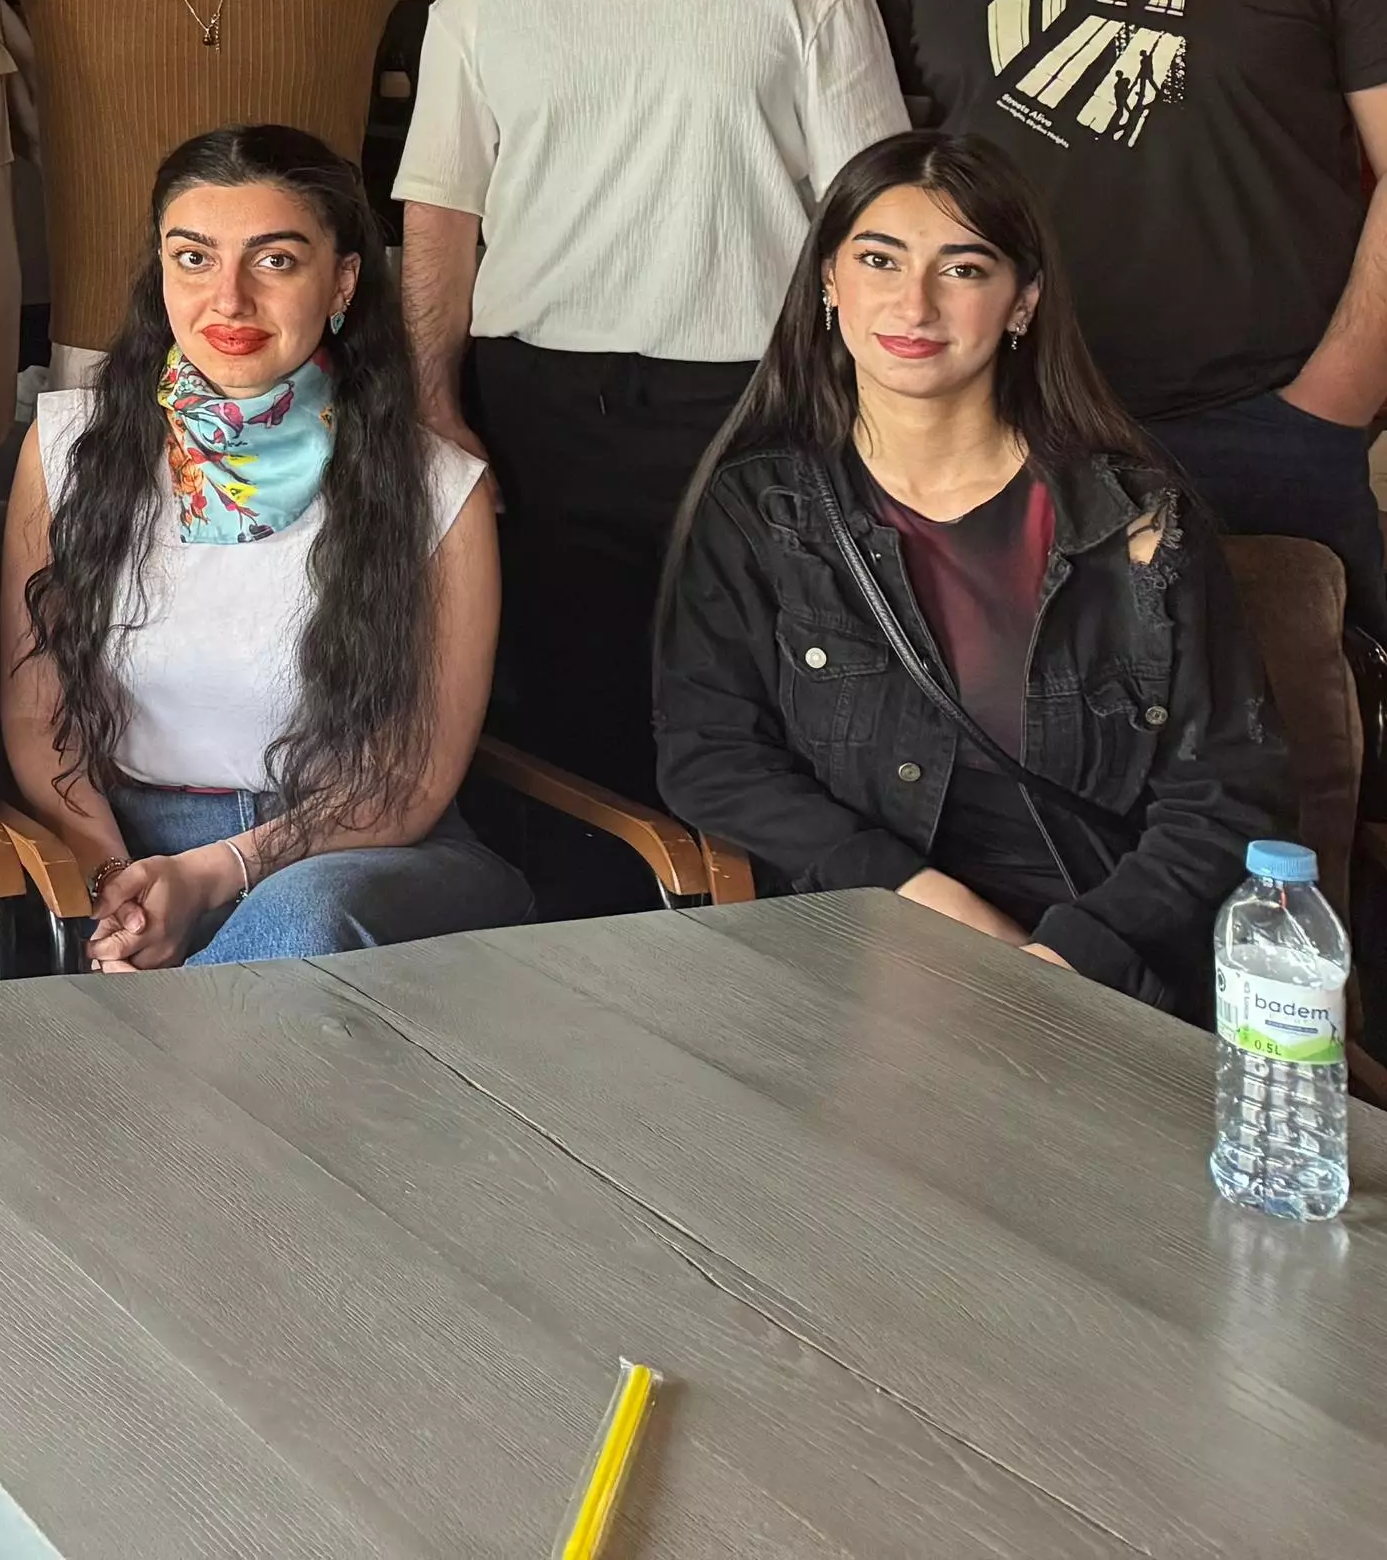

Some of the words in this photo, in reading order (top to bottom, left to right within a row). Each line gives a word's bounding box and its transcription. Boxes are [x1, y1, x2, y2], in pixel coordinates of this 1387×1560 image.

[1028, 111, 1052, 127] Alive
[1255, 993, 1328, 1020] badem
[1254, 1040, 1282, 1056] 0.5L
